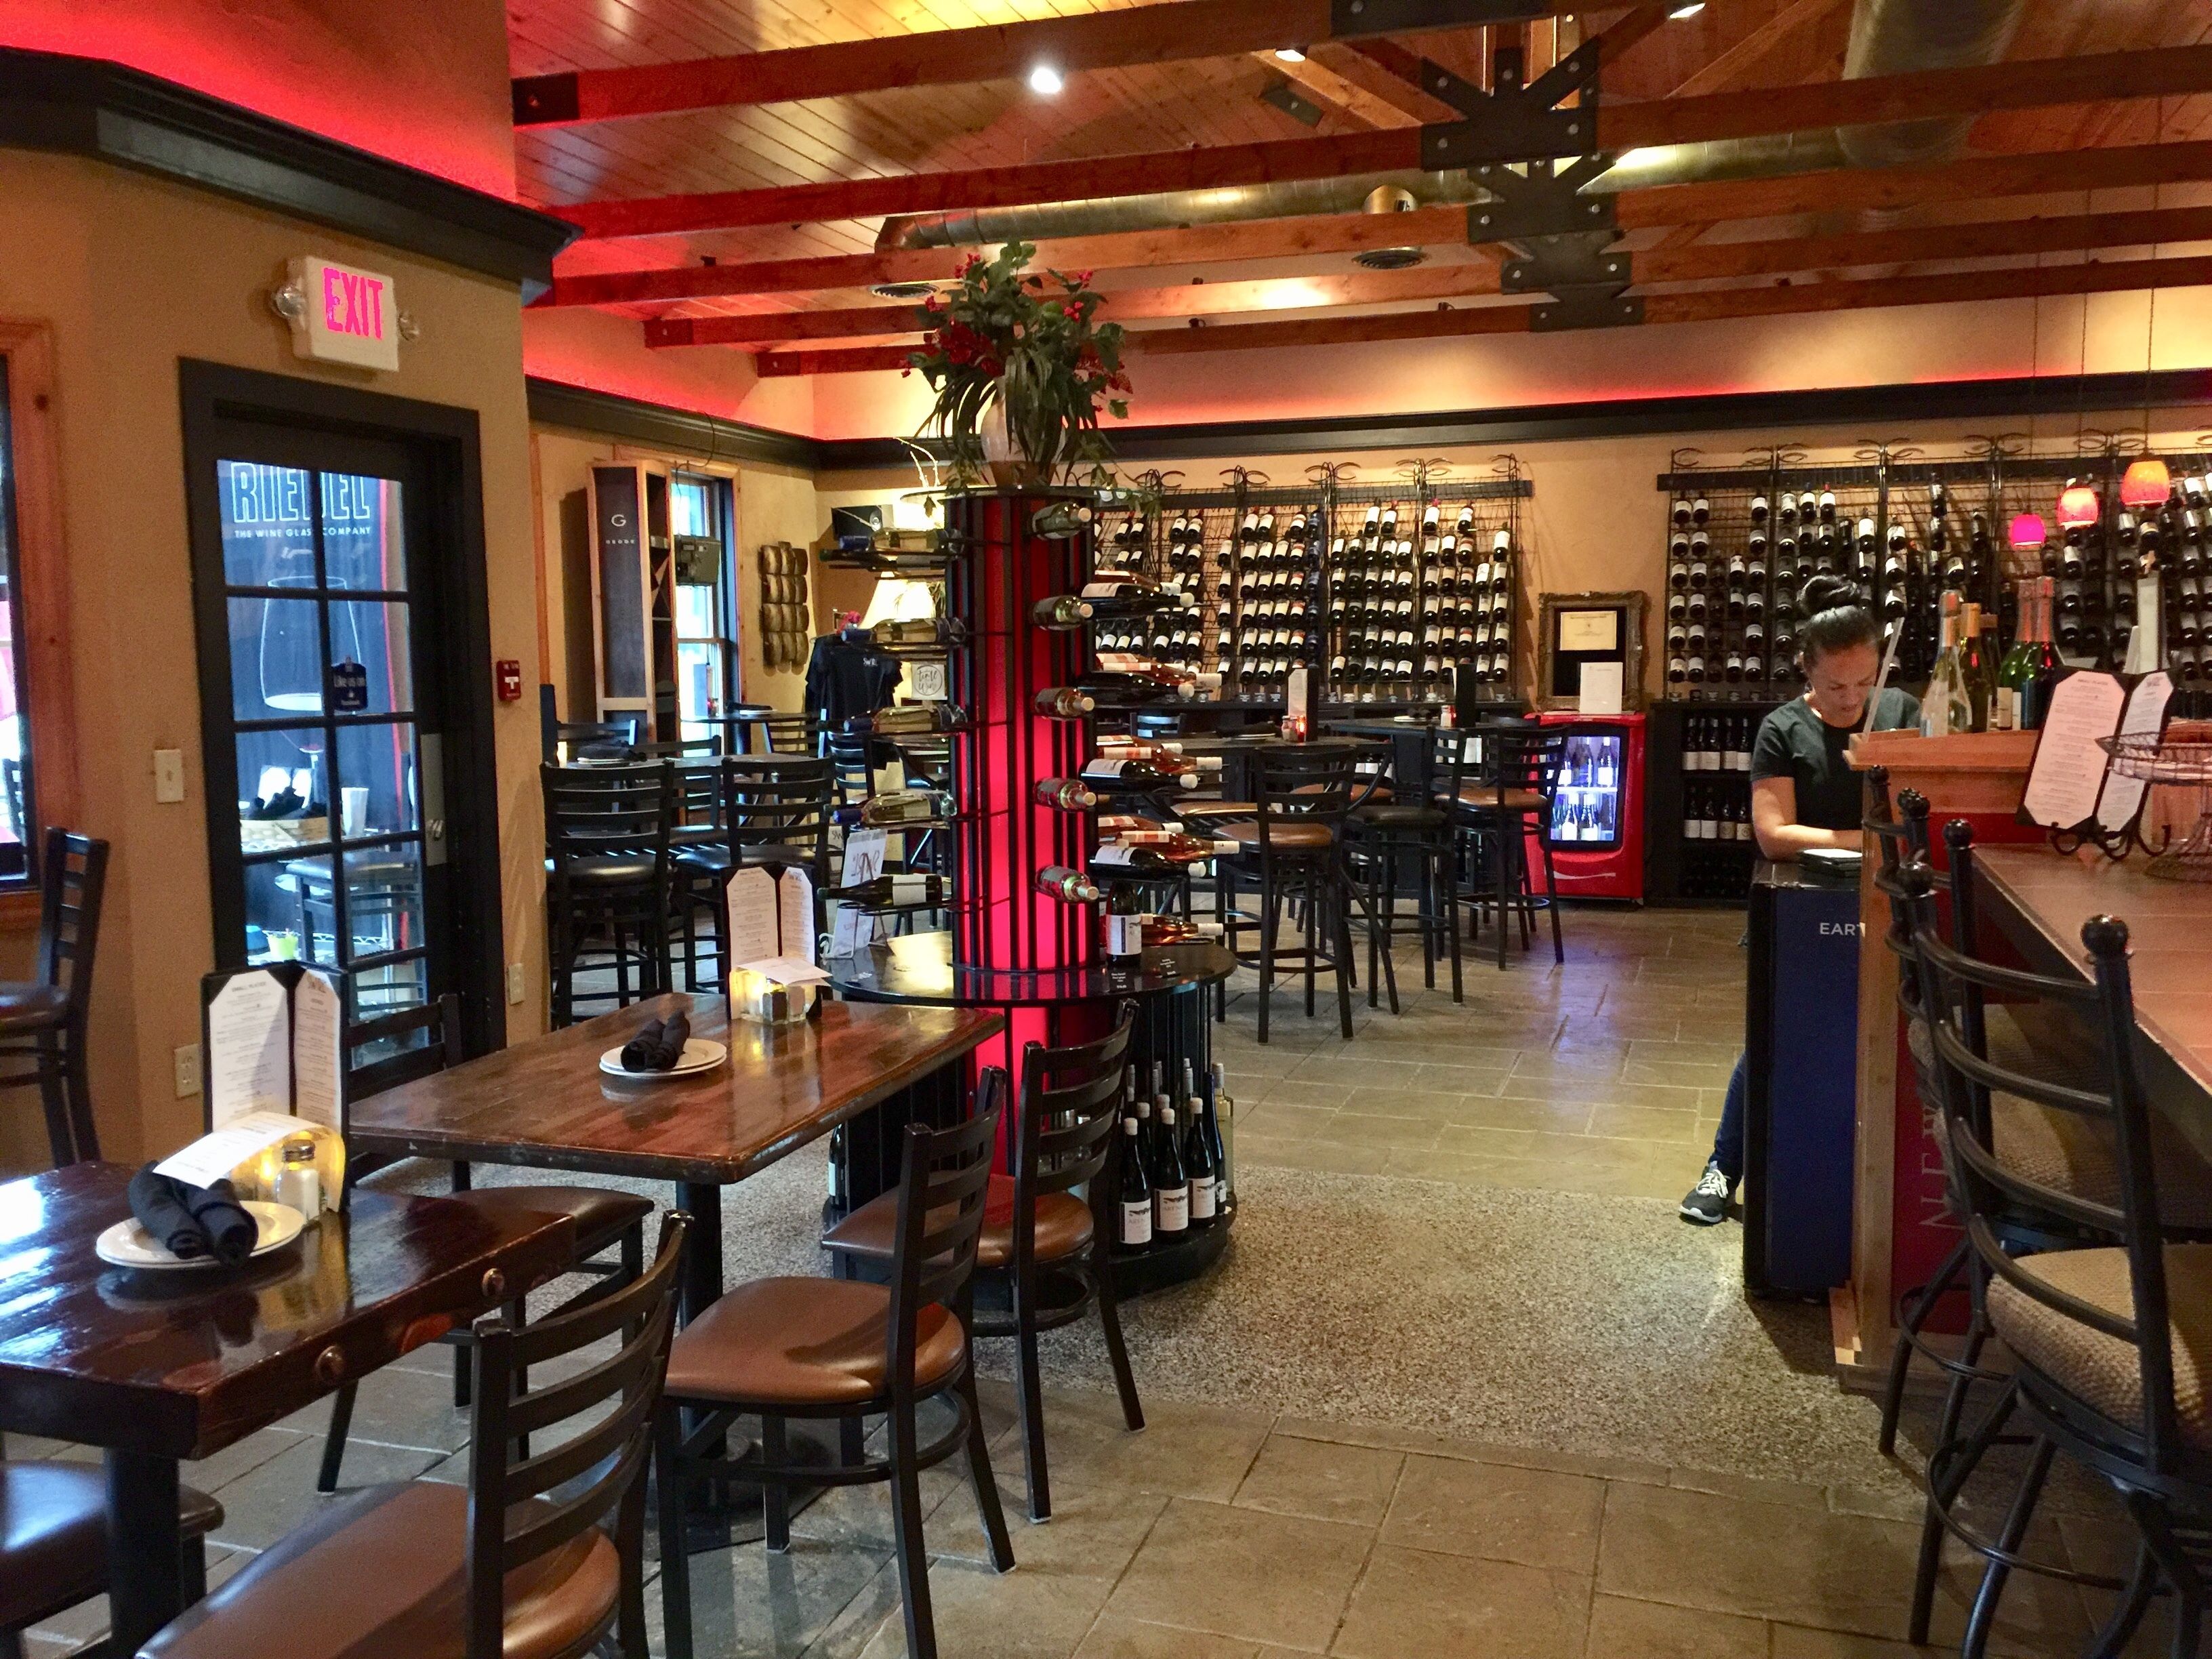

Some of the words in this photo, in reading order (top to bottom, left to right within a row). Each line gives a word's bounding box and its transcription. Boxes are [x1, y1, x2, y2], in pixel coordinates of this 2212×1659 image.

[323, 267, 384, 340] EXIT
[611, 514, 627, 527] G
[234, 530, 252, 539] THE
[255, 529, 282, 538] WINE
[285, 528, 312, 537] GLAS
[322, 526, 371, 536] COMPANY
